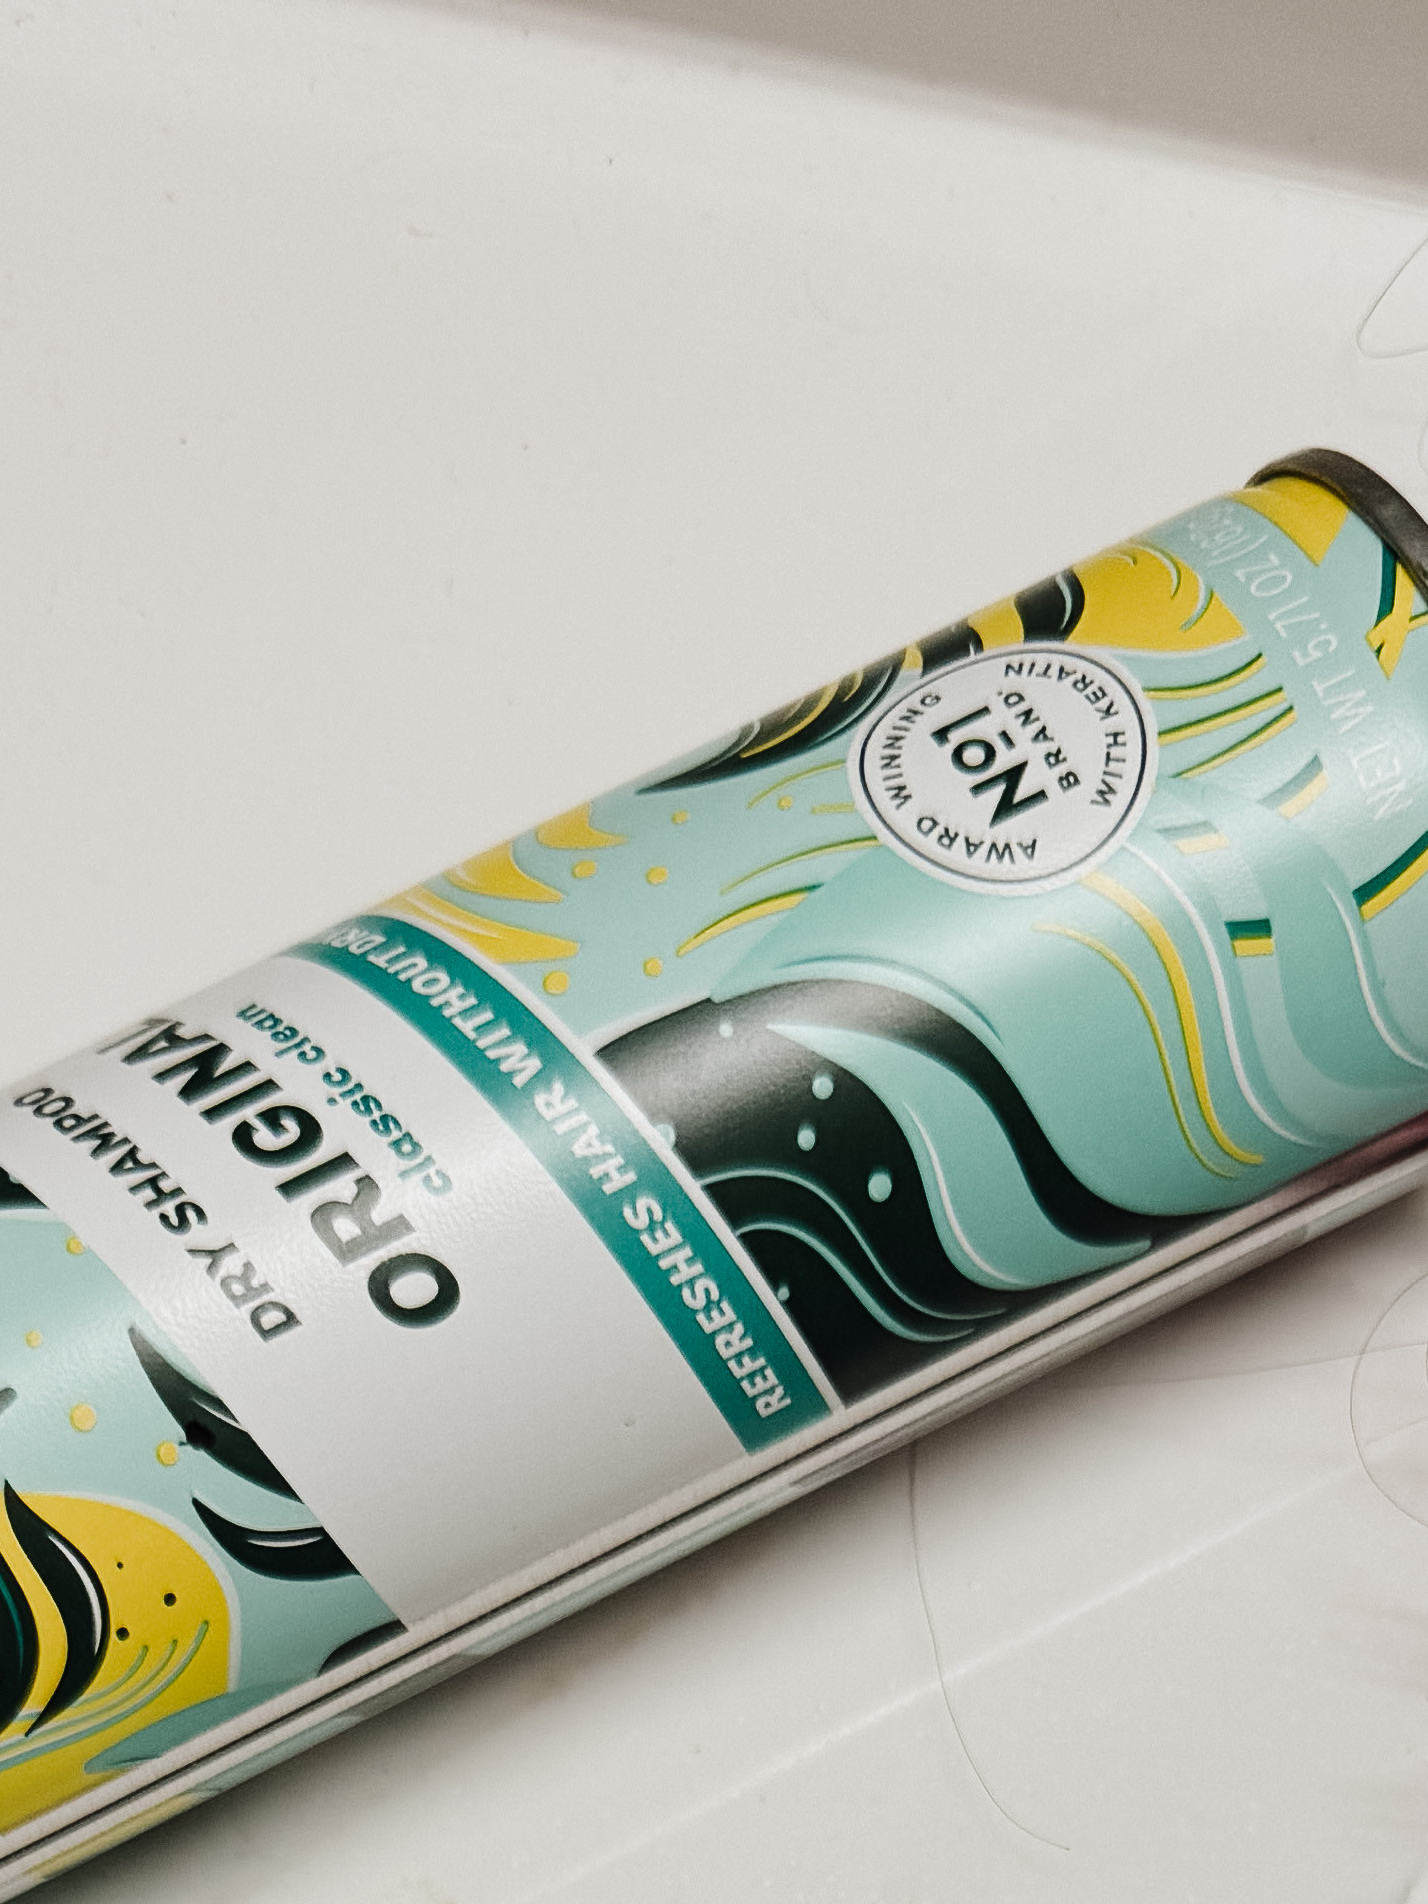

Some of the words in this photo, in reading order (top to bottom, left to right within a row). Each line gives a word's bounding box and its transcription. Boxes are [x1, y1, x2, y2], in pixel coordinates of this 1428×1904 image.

[1233, 553, 1293, 598] OZ
[1267, 596, 1338, 667] 5.71
[1004, 661, 1119, 722] KERATIN
[1311, 669, 1373, 735] WT
[880, 692, 942, 811] WINNING
[1090, 730, 1127, 808] WITH
[1351, 742, 1414, 822] NET
[916, 815, 1038, 865] AWARD
[324, 925, 388, 956] DR
[235, 1002, 326, 1067] clean
[367, 945, 544, 1090] WITHOUT
[12, 1086, 209, 1237] SHAMPOO
[322, 1066, 454, 1197] classic
[533, 1079, 638, 1196] HAIR
[184, 1242, 304, 1343] DRY
[622, 1195, 792, 1419] REFRESHES
